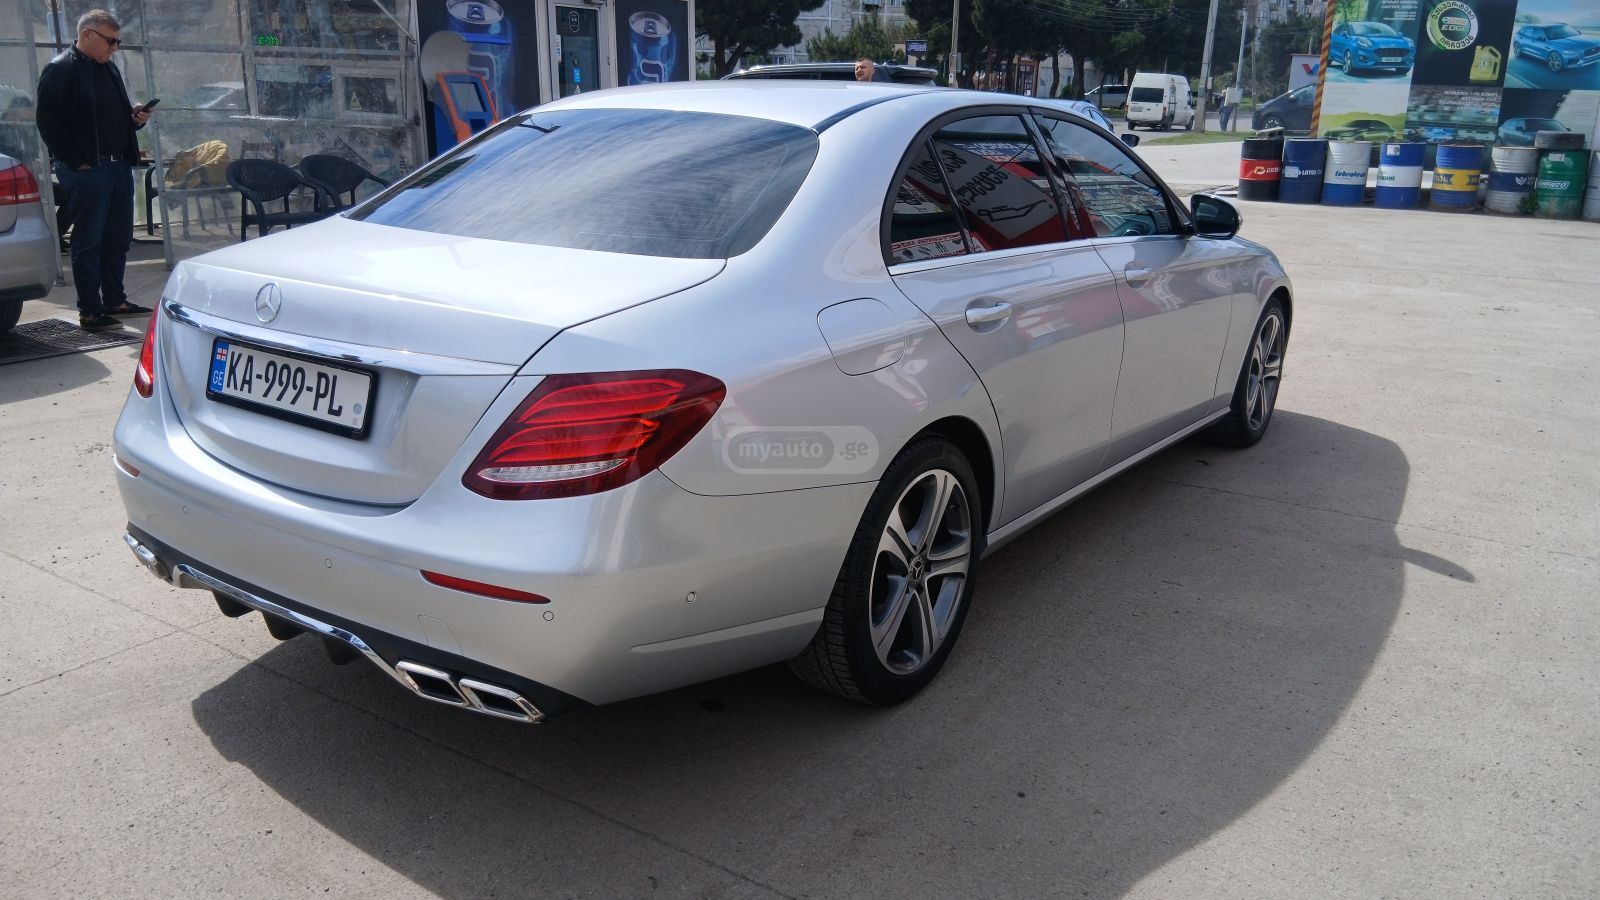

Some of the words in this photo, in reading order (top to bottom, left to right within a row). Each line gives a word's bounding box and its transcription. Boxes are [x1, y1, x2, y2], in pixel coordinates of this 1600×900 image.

[1441, 24, 1468, 32] EDGE
[212, 370, 224, 386] GE
[226, 350, 343, 417] KA-999-PL
